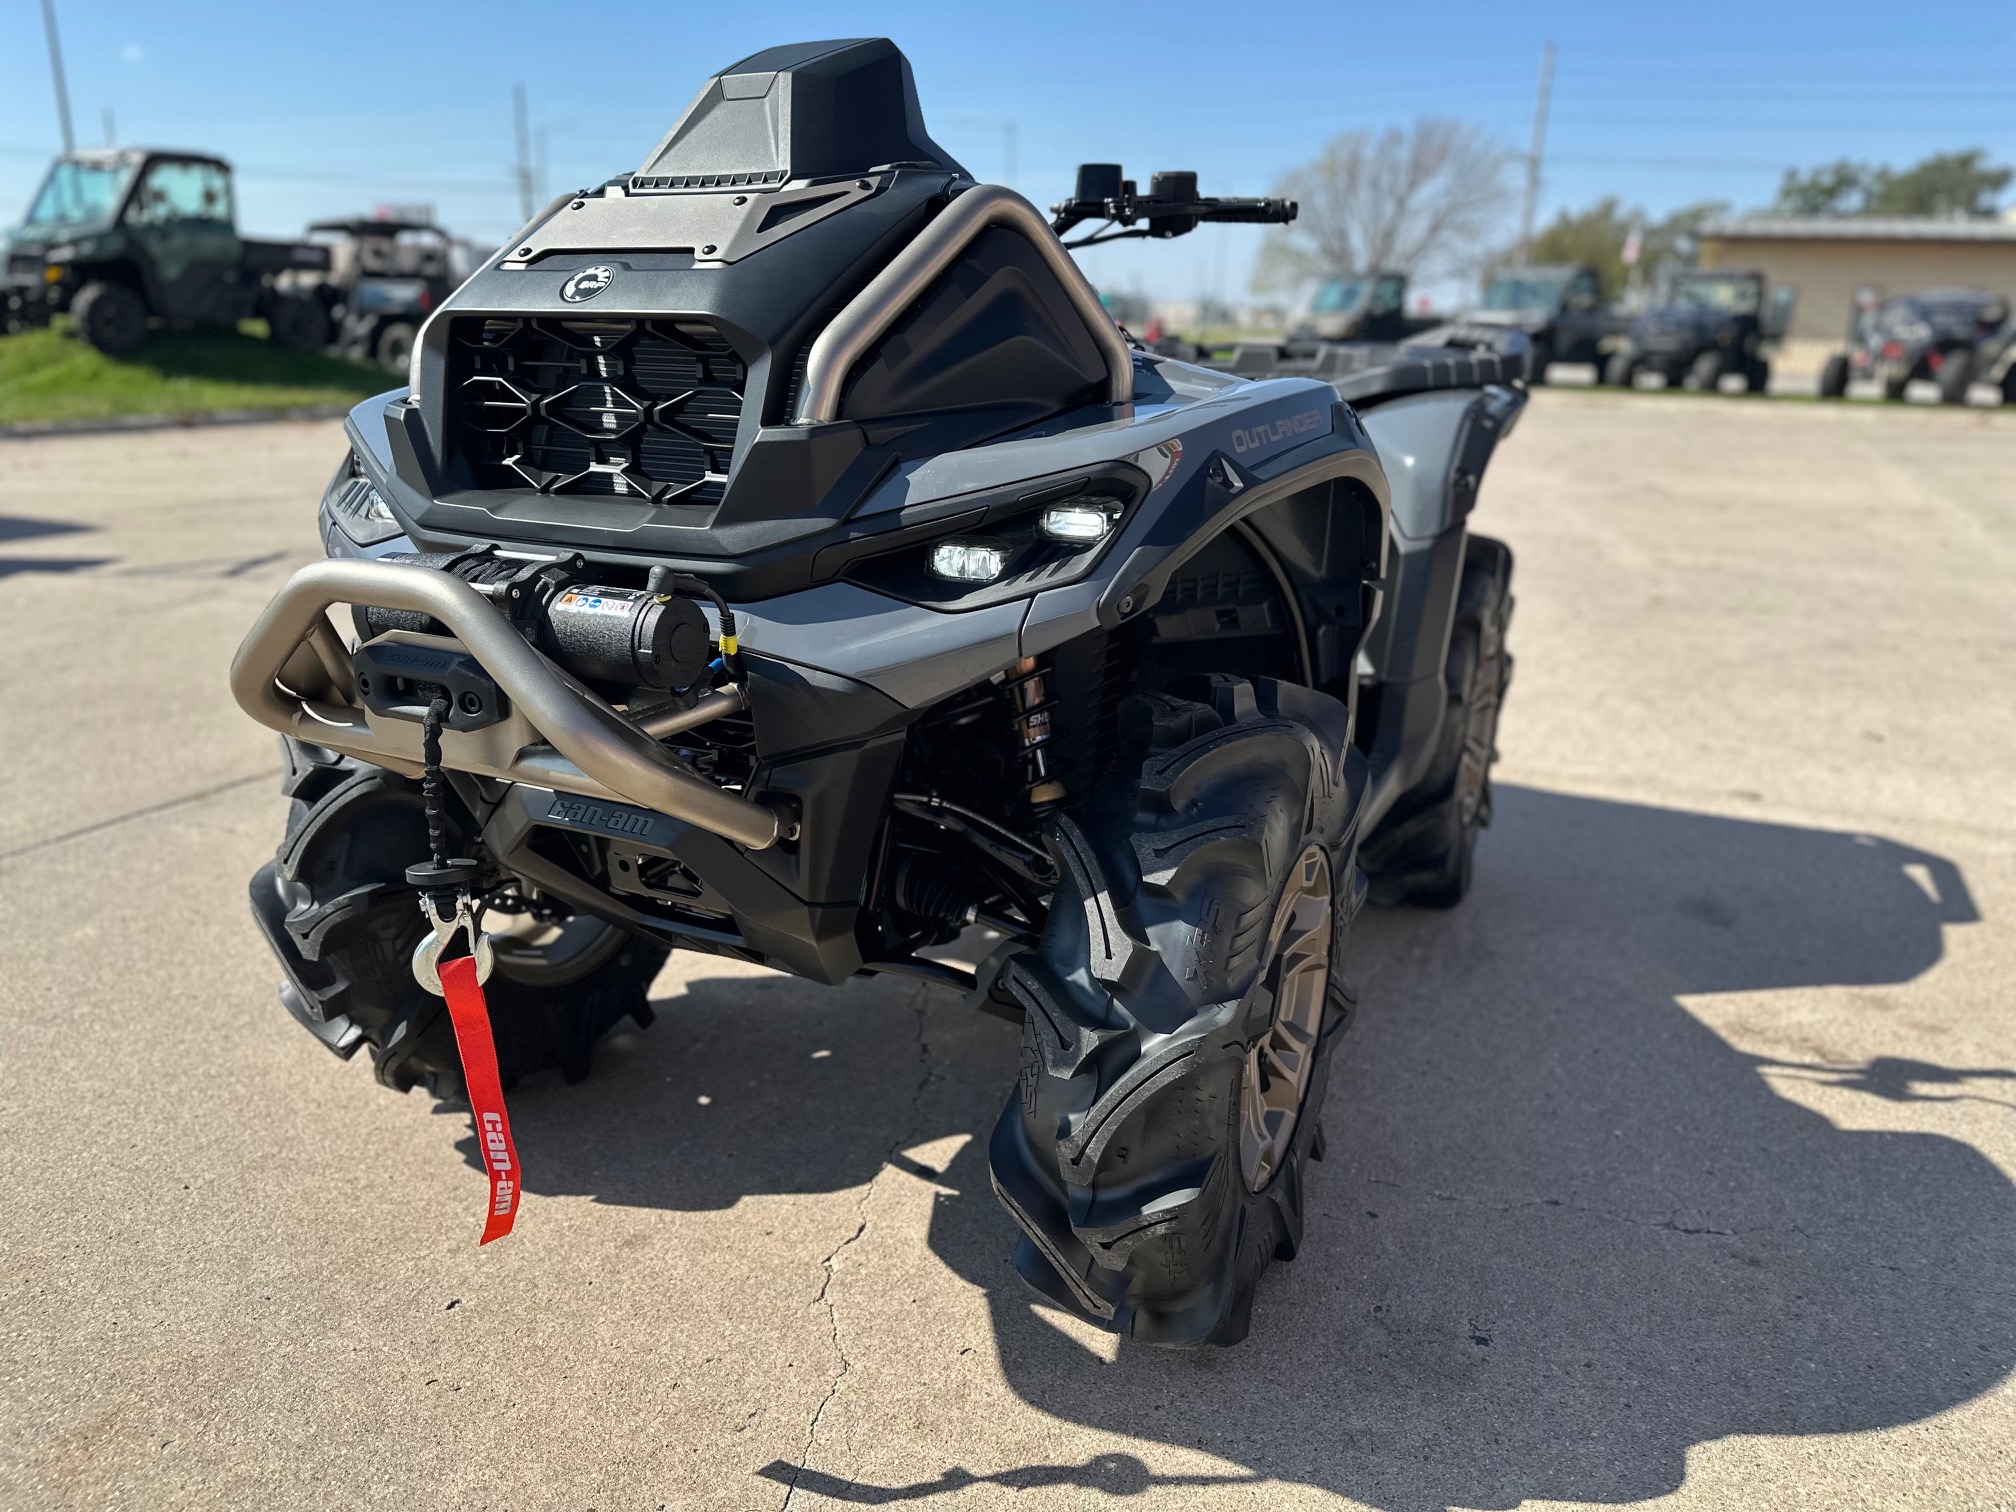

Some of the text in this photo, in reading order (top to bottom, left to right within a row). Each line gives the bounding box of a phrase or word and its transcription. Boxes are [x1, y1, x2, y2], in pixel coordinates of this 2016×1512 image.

[577, 280, 606, 289] BRP
[1231, 409, 1321, 455] OUTLANDER
[547, 799, 655, 837] can-am
[482, 1112, 515, 1216] can-am
